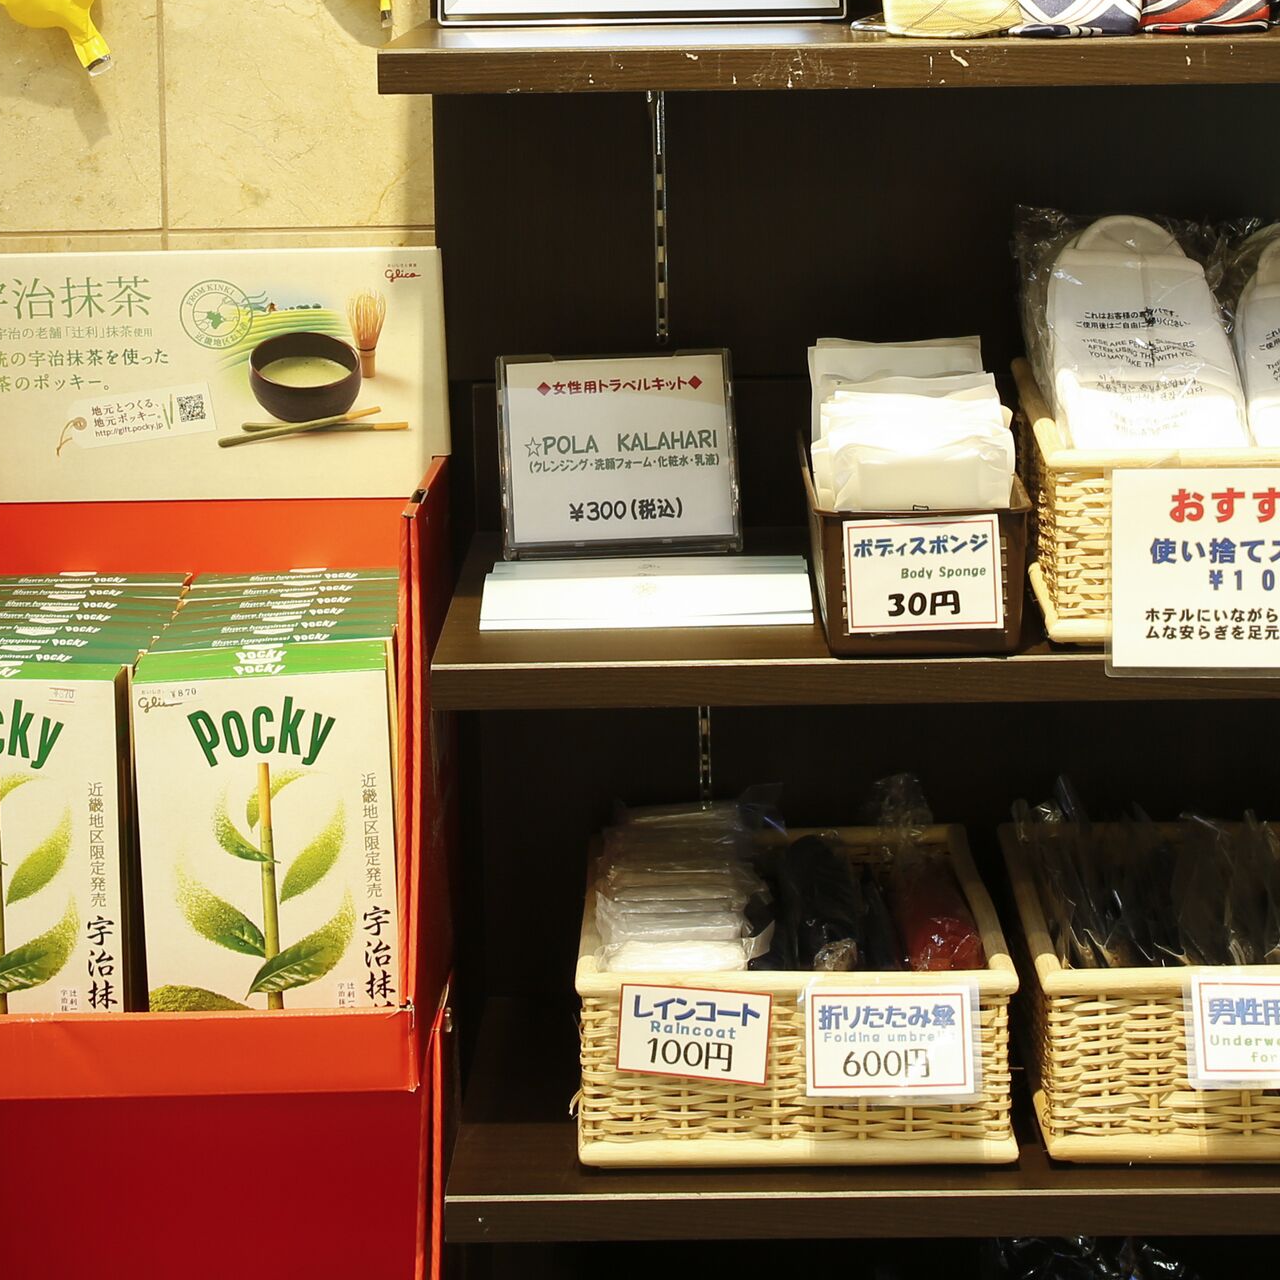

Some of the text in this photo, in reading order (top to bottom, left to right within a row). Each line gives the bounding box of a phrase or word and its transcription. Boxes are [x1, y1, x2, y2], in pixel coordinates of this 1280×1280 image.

[384, 269, 421, 282] Glico
[207, 283, 236, 296] KINKI
[552, 376, 688, 395] 女性用トラベルキット
[543, 429, 718, 455] POLA KALAHARI
[852, 532, 989, 558] ボディスポンジ
[900, 564, 988, 581] Body Sponge
[886, 589, 962, 617] 30円
[87, 781, 107, 908] 近畿地区限定発売
[361, 772, 383, 898] 近畿地区限定発売
[363, 905, 396, 1007] 宇治抹
[633, 994, 761, 1026] レインコート
[818, 1004, 956, 1031] 折りたたみ傘
[650, 1020, 737, 1040] Raincoat
[824, 1031, 955, 1043] Folding umbre
[647, 1038, 733, 1072] 100円
[842, 1048, 930, 1078] 600円
[1251, 1051, 1277, 1063] for
